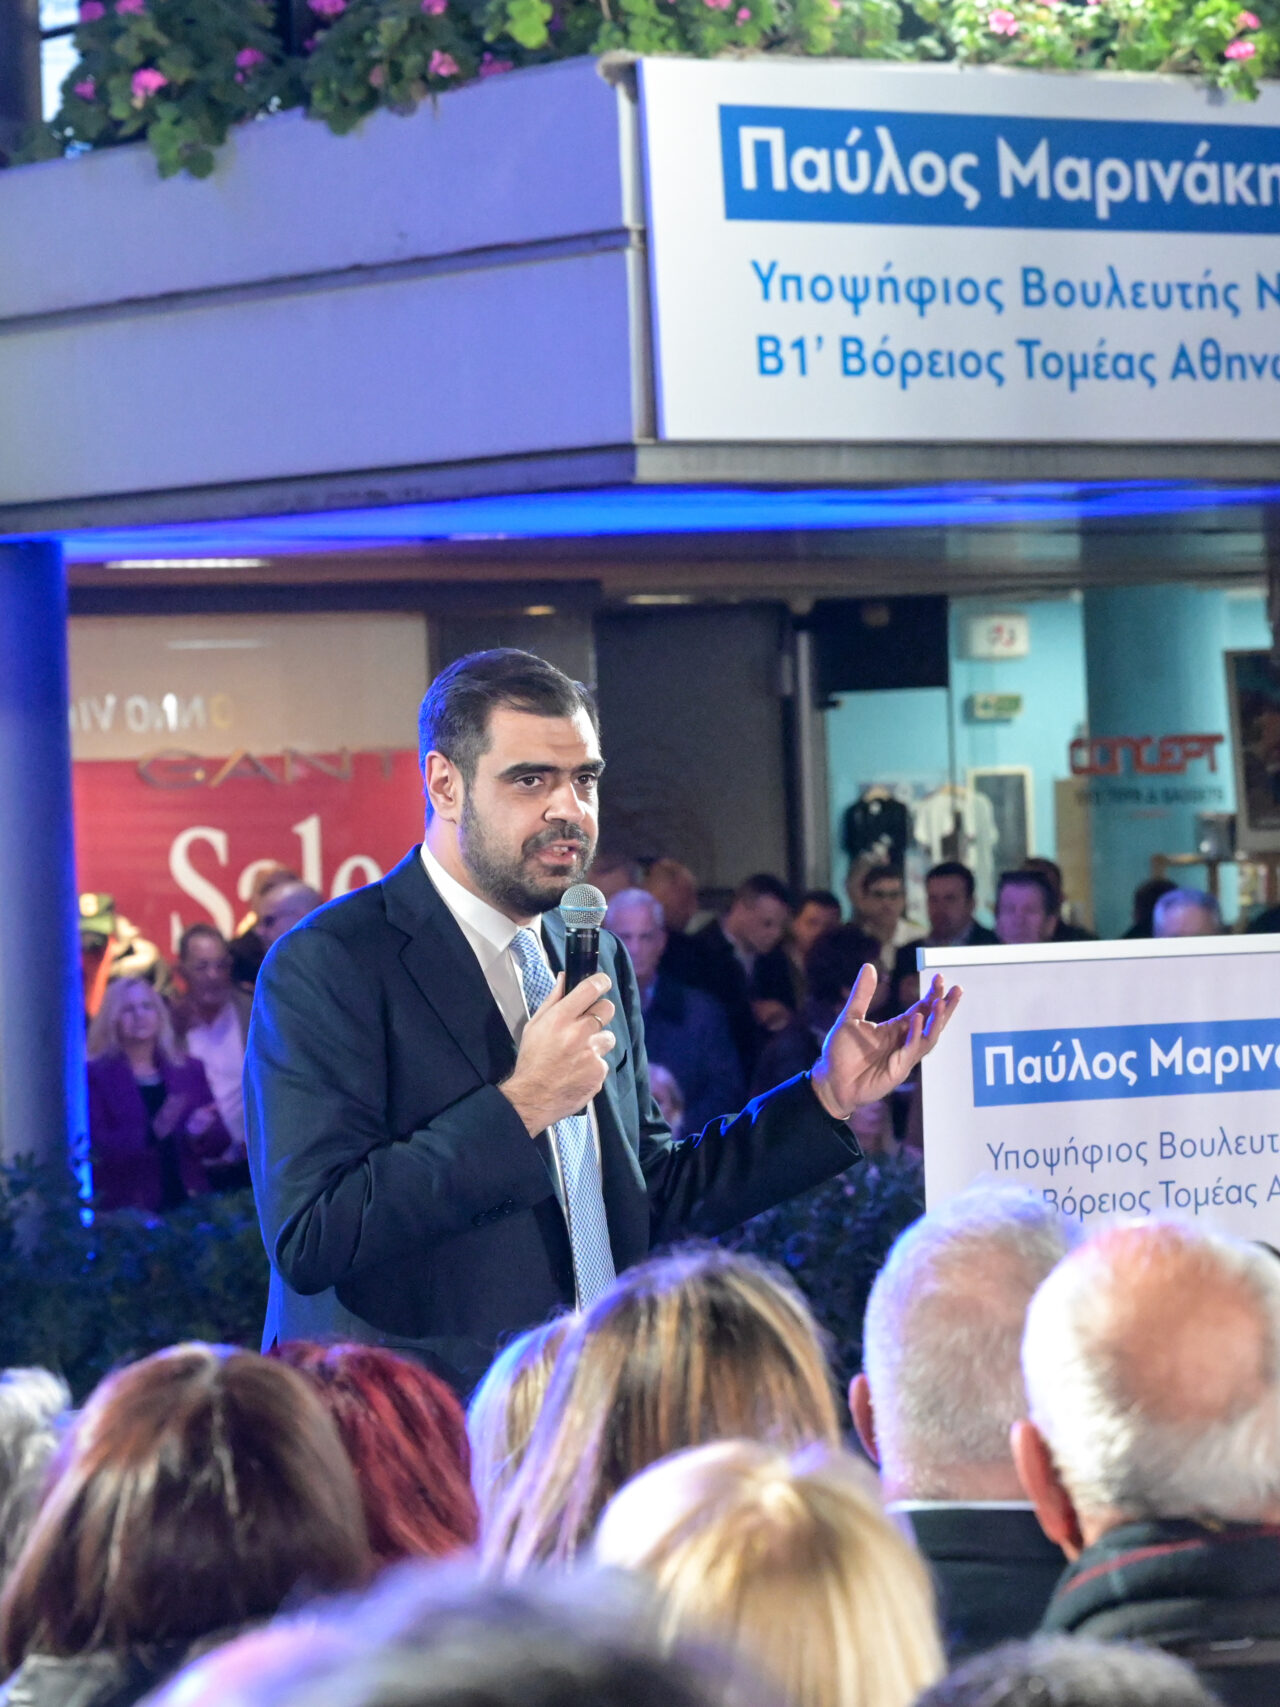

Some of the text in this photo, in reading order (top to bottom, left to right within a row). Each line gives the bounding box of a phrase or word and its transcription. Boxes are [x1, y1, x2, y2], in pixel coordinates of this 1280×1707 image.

[737, 126, 981, 211] Παύλος
[751, 261, 1004, 317] Υποψήφιος
[1020, 266, 1241, 317] Βουλευτής
[841, 336, 1004, 390] Βόρειος
[1017, 339, 1157, 391] Τομέας
[984, 1039, 1137, 1086] Παύλος
[986, 1136, 1148, 1175] Υποψήφιος
[1042, 1187, 1151, 1222] Βόρειος
[1159, 1177, 1258, 1217] Τομέας
